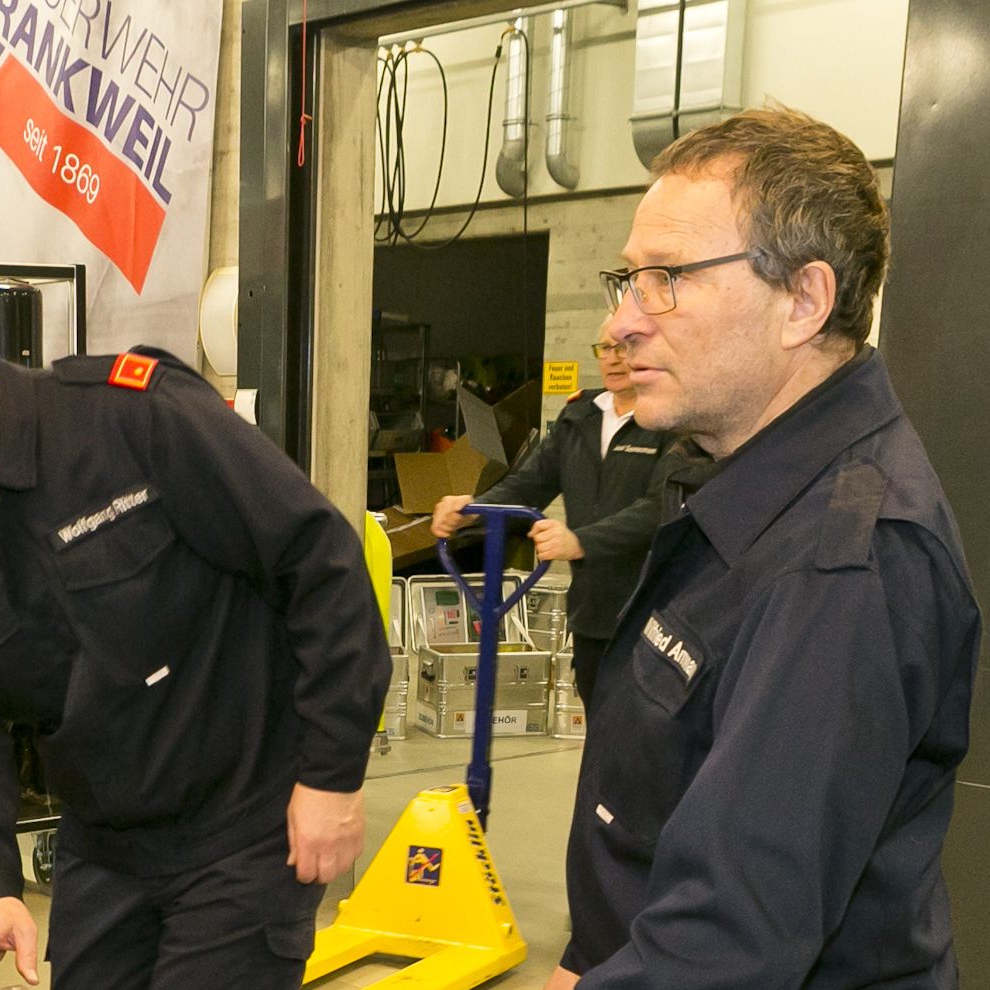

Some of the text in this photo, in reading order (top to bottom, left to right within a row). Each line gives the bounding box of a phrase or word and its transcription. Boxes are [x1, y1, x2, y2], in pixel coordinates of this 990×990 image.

[23, 118, 100, 204] seit 1869
[57, 506, 115, 544] Wolfgang
[492, 716, 517, 725] EHÖR
